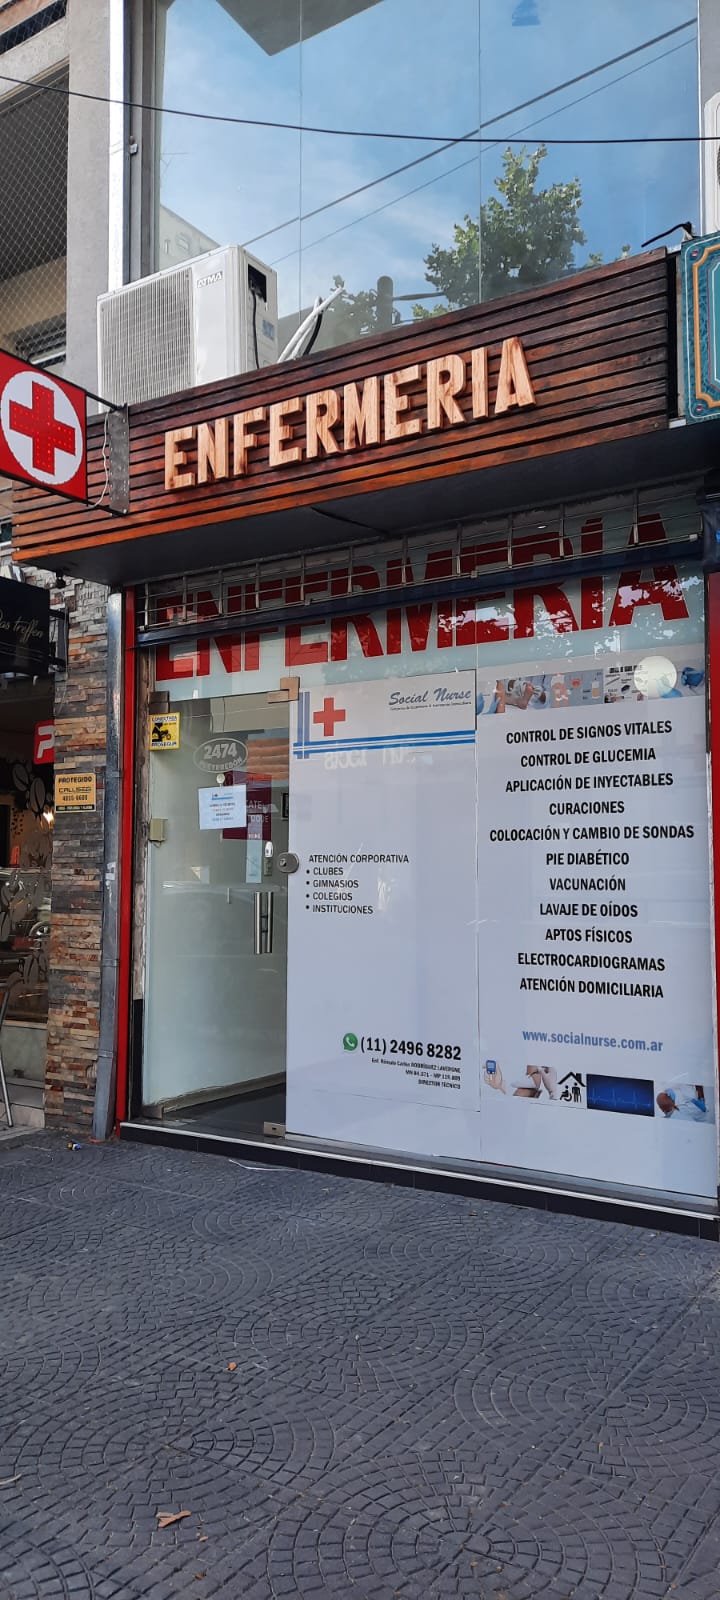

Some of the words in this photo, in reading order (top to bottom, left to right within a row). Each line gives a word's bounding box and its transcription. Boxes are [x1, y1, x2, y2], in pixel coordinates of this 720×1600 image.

[164, 336, 537, 491] ENFERMERIA
[155, 511, 690, 682] ENFERMERIA
[388, 690, 429, 706] Social
[434, 687, 472, 702] Nurse
[506, 730, 556, 744] CONTROL
[559, 727, 574, 740] DE
[577, 724, 622, 739] SIGNOS
[624, 720, 672, 736] VITALES
[203, 742, 238, 760] 2474
[520, 753, 571, 768] CONTROL
[575, 751, 590, 764] DE
[593, 748, 656, 763] GLUCEMIA
[58, 776, 93, 784] PROTEGIDO
[505, 774, 572, 793] APLICACIÓN
[575, 776, 590, 789] DE
[593, 773, 674, 789] INYECTABLES
[549, 801, 625, 815] CURACIONES
[490, 825, 560, 842] COLOCACIÓN
[562, 828, 571, 840] Y
[572, 826, 621, 840] CAMBIO
[624, 826, 640, 839] DE
[643, 825, 694, 838] SONDAS
[309, 853, 348, 864] ATENCIÓN
[350, 854, 409, 864] CORPORATIVA
[546, 852, 565, 865] PIE
[567, 849, 630, 865] DIABÉTICO
[313, 867, 344, 876] CLUBES
[313, 879, 359, 889] GIMNASIOS
[549, 875, 626, 891] VACUNACIÓN
[313, 892, 353, 901] COLEGIOS
[312, 904, 373, 914] INSTITUCIONES
[540, 903, 579, 916] LAVAJE
[582, 904, 597, 916] DE
[600, 901, 638, 917] OÍDOS
[545, 928, 582, 942] APTOS
[585, 926, 633, 943] FÍSICOS
[518, 952, 666, 972] ELECTROCARDIOGRAMAS
[519, 976, 575, 993] ATENCIÓN
[578, 983, 664, 998] DOMICILIARIA
[361, 1036, 387, 1055] (11)
[390, 1039, 424, 1057] 2496
[426, 1043, 462, 1061] 8282
[522, 1029, 663, 1052] www.socialnurse.com.ar
